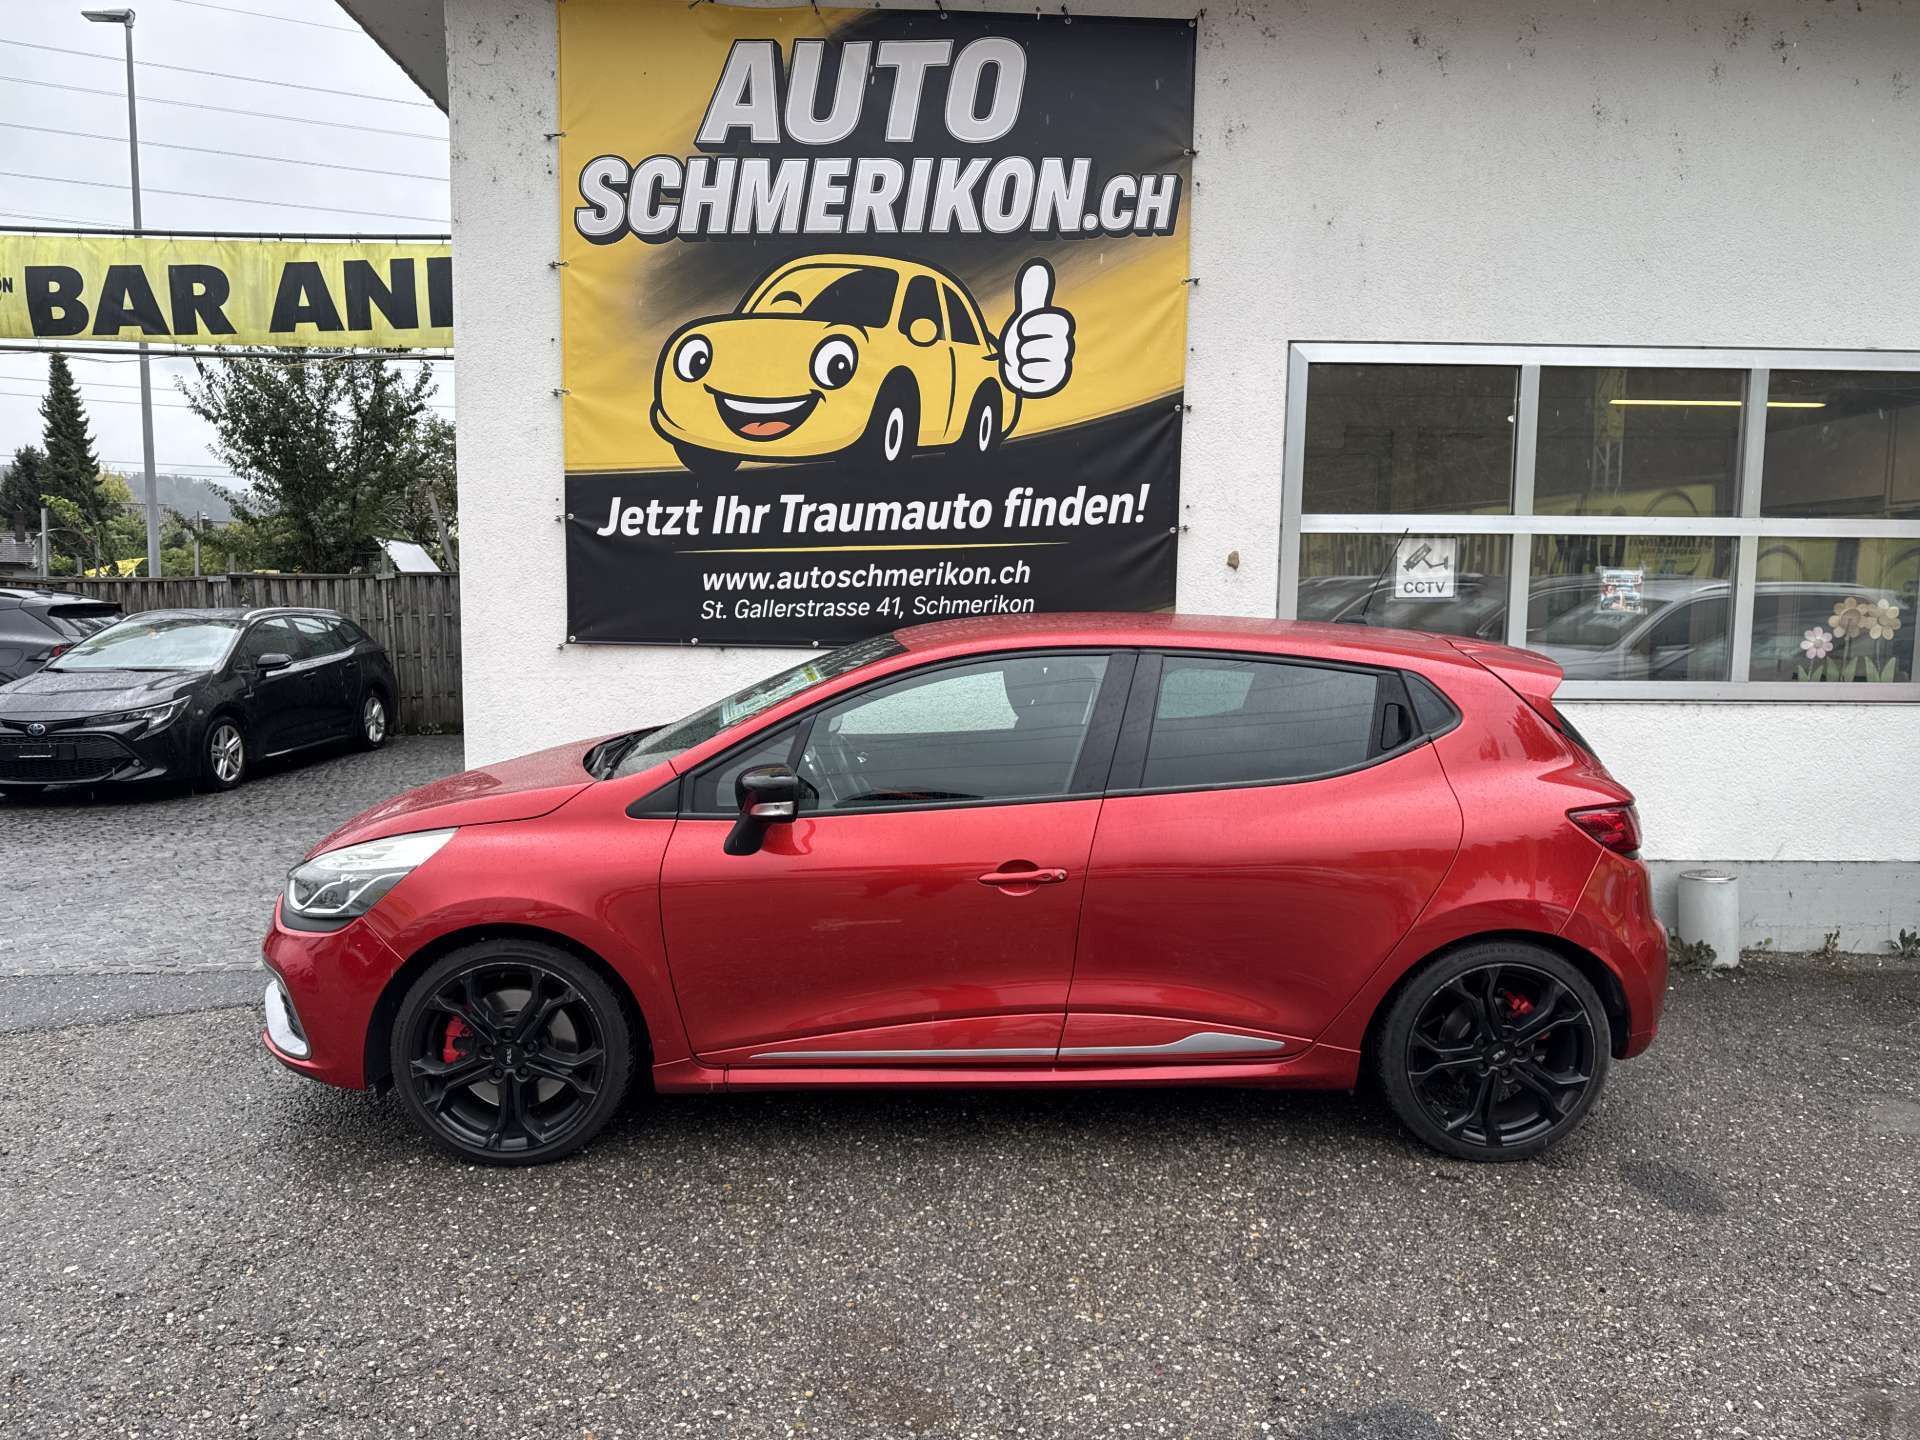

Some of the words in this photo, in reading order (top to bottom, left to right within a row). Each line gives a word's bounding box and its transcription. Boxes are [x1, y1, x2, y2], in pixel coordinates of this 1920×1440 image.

[697, 36, 1027, 146] AUTO
[575, 156, 1177, 236] SCHMERIKON.CH
[24, 264, 237, 336] BAR
[596, 496, 703, 537] Jetzt
[711, 494, 771, 535] Ihr
[779, 493, 993, 533] Traumauto
[1002, 483, 1151, 528] finden!
[702, 560, 1032, 592] www.autoschmerikon.ch
[1403, 581, 1446, 594] CCTV
[700, 600, 728, 620] St.
[734, 598, 871, 620] Gallerstrasse
[876, 596, 905, 620] 41,
[912, 593, 1036, 617] Schmerikon
